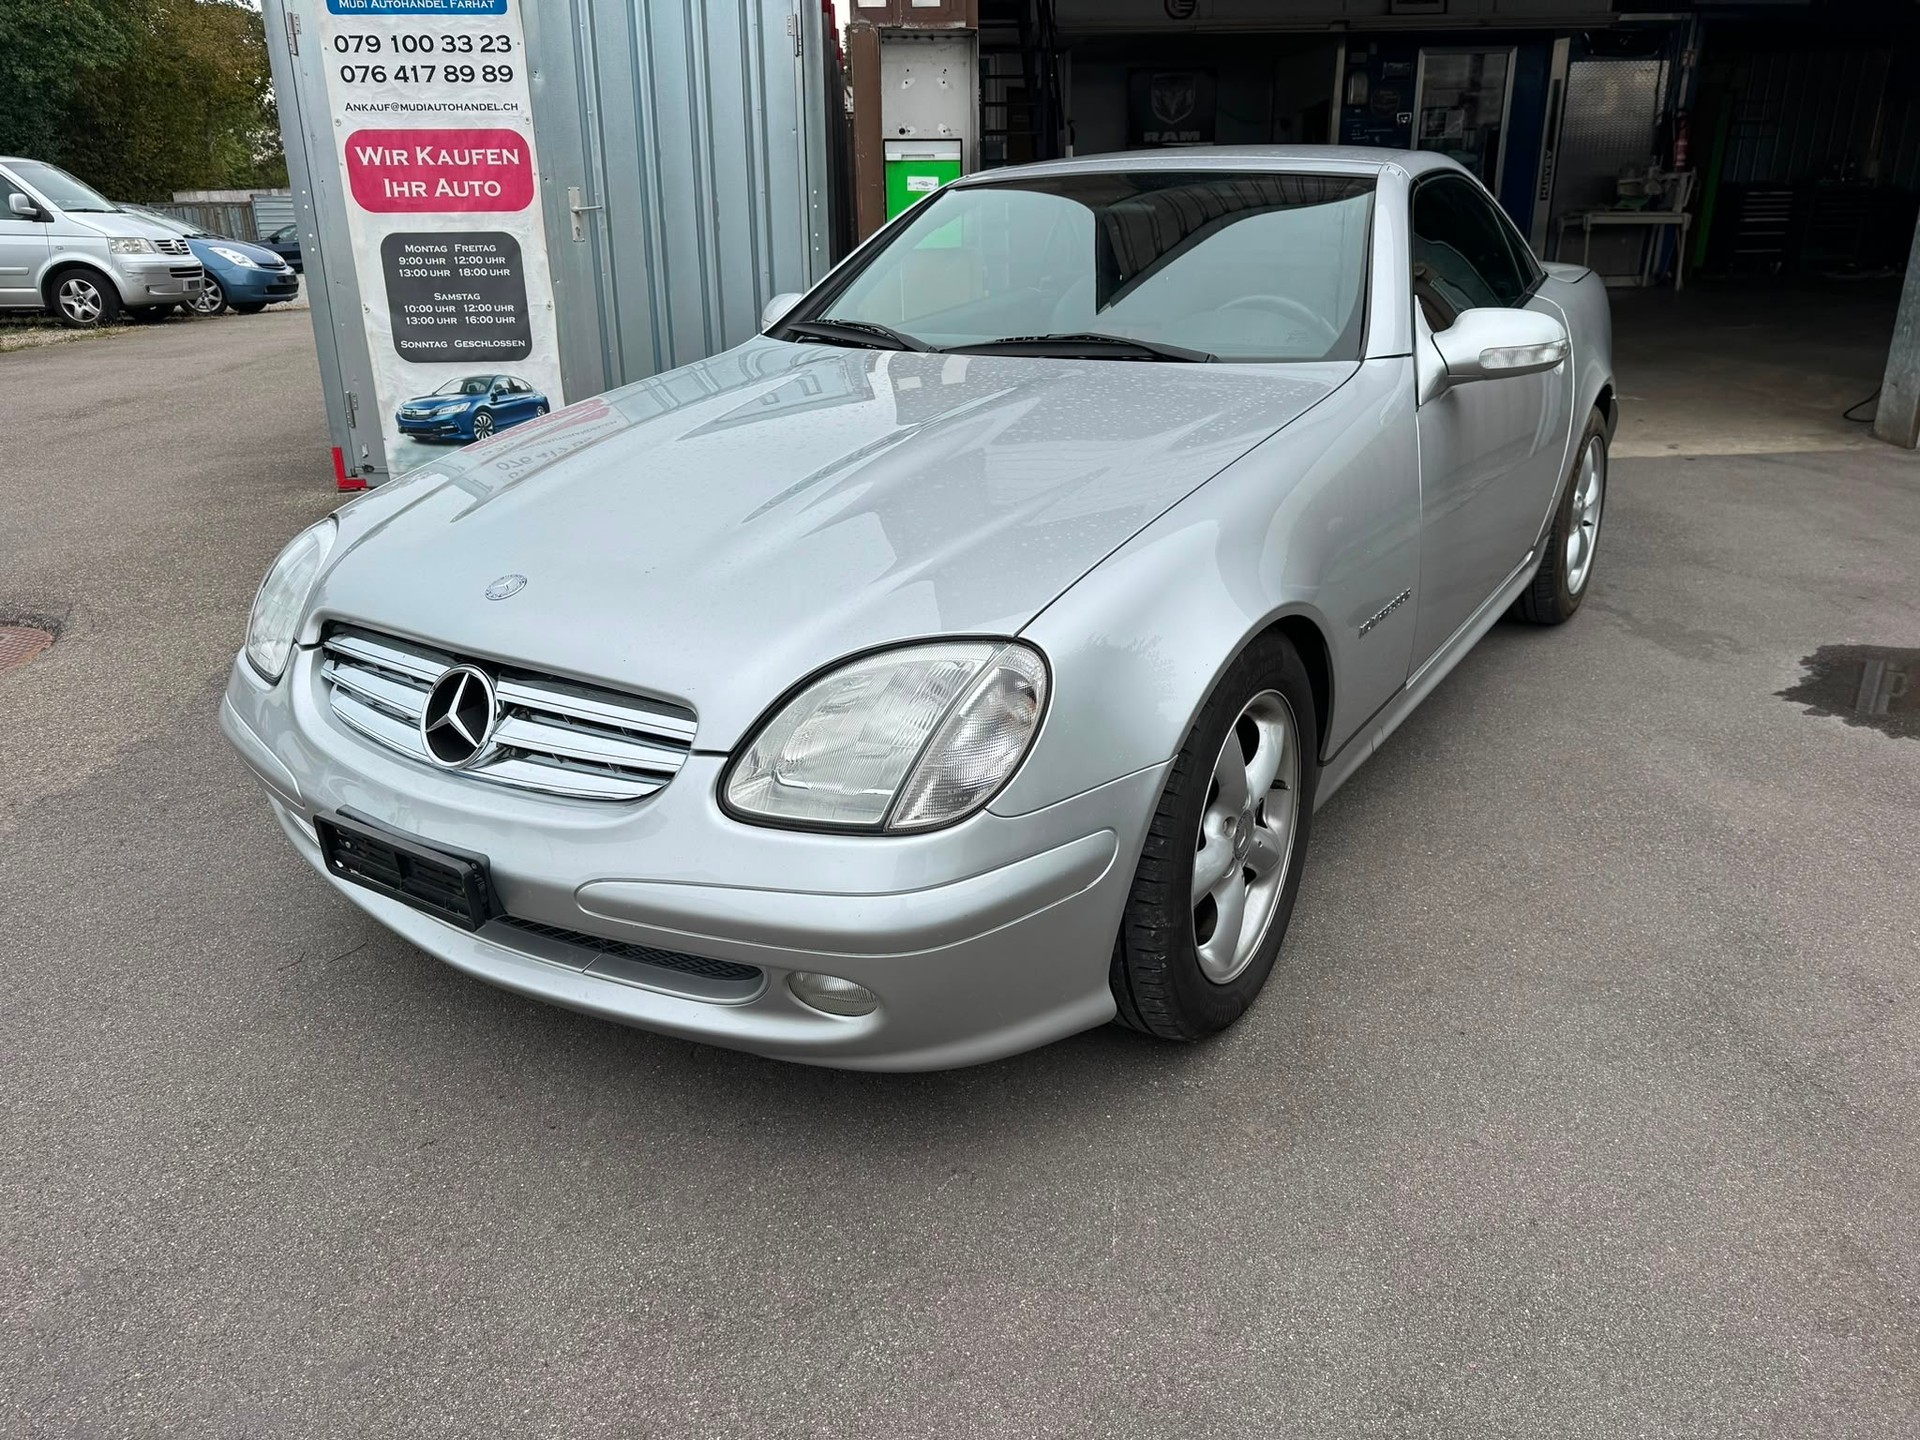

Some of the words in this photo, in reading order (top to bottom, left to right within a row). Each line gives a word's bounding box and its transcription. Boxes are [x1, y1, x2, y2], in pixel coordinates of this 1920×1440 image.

[334, 35, 381, 53] 079
[391, 35, 434, 53] 100
[441, 35, 473, 53] 33
[479, 35, 512, 53] 23
[340, 65, 387, 83] 076
[394, 65, 436, 83] 417
[444, 65, 475, 83] 89
[482, 65, 514, 83] 89
[1143, 131, 1200, 143] RAM
[354, 146, 409, 166] WIR
[416, 146, 520, 165] KAUFEN
[384, 178, 430, 197] IHR
[435, 178, 501, 197] AUTO
[399, 256, 423, 265] 9:00
[425, 257, 446, 265] UHR
[454, 256, 483, 265] 12:00
[399, 269, 428, 277] 13:00
[430, 269, 451, 277] UHR
[458, 268, 488, 277] 18:00
[490, 268, 511, 276] UHR
[404, 304, 433, 313] 10:00
[435, 305, 456, 313] UHR
[463, 304, 492, 312] 12:00
[494, 304, 515, 312] UHR
[406, 316, 435, 325] 13:00
[436, 317, 458, 325] UHR
[465, 316, 494, 324] 16:00
[496, 316, 516, 324] UHR
